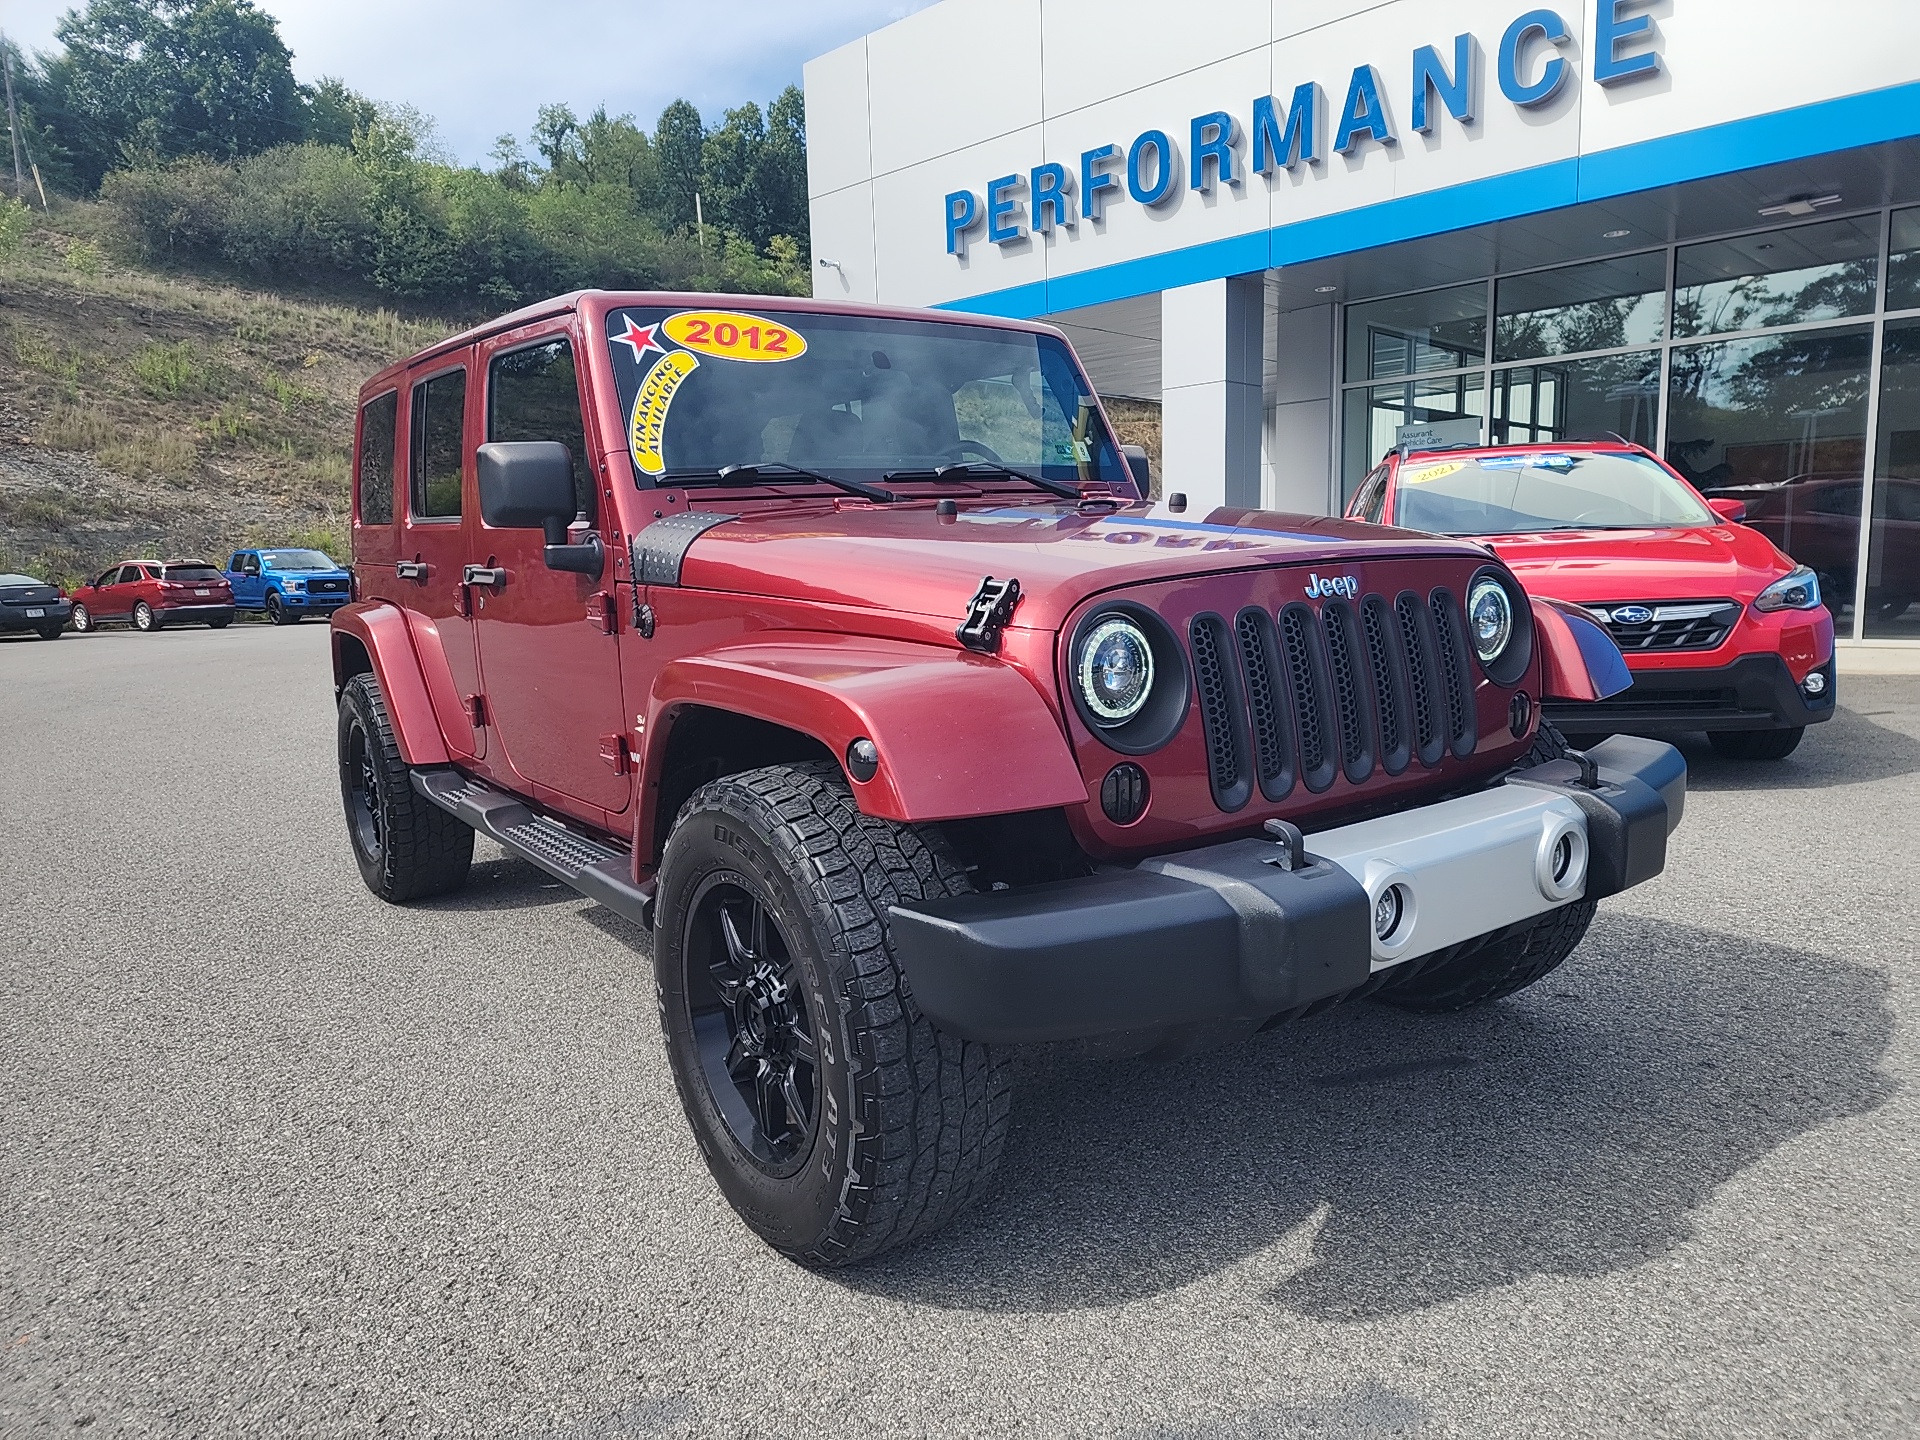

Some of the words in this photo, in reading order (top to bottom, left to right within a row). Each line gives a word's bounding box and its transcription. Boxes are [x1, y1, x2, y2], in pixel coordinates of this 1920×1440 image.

[945, 0, 1661, 255] PERFORMANCE
[683, 319, 789, 353] 2012
[635, 359, 673, 455] FINANCING
[648, 366, 685, 457] AVAILABLE
[1401, 429, 1433, 439] Assurant
[1426, 437, 1443, 445] Care
[1418, 464, 1456, 481] 2021
[1304, 573, 1359, 600] Jeep
